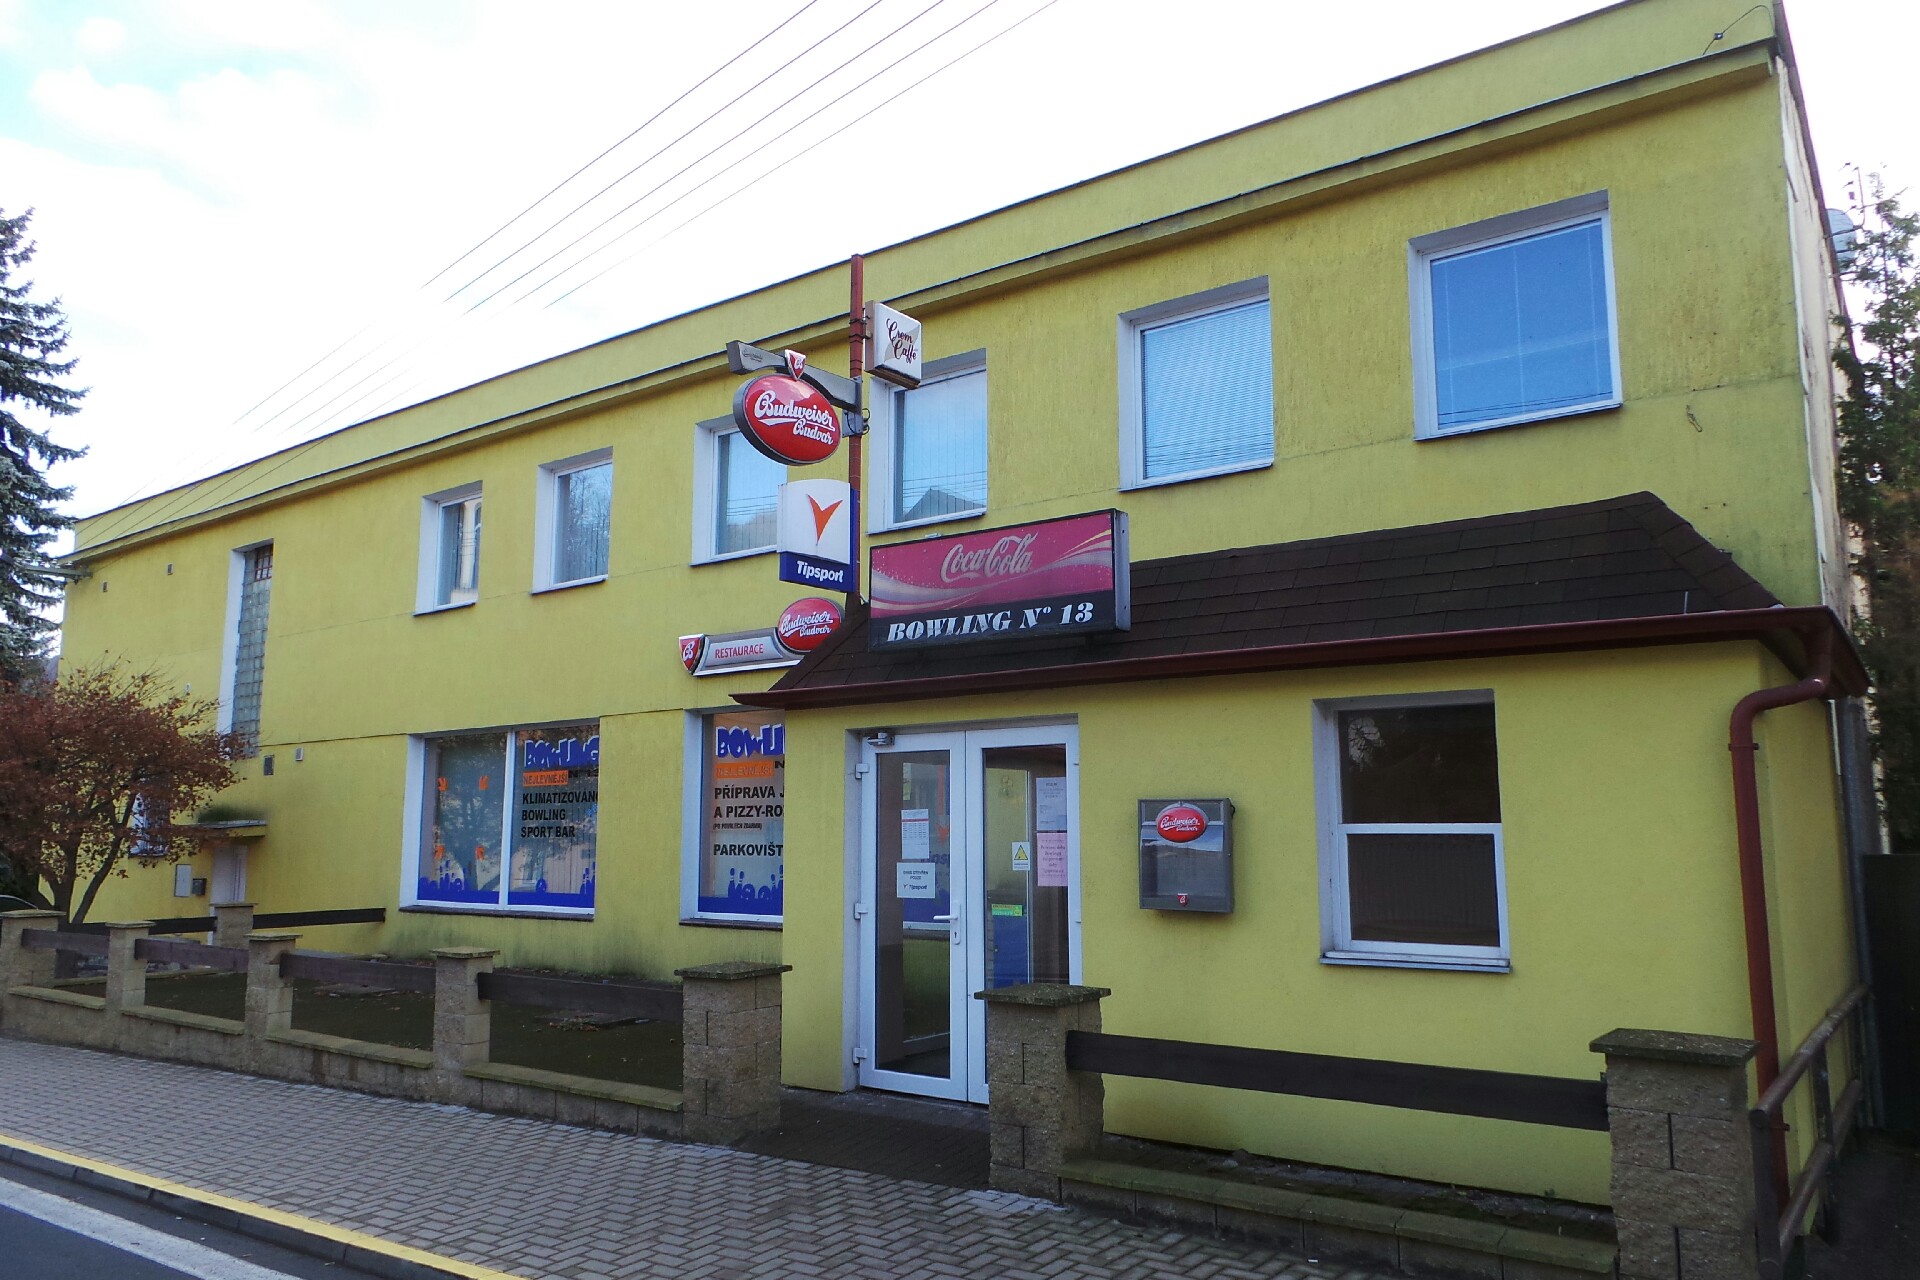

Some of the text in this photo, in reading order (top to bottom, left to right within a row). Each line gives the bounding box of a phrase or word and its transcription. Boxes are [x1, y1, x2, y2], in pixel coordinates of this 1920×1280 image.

[754, 389, 836, 431] Budweiser
[793, 419, 834, 445] Budvar
[797, 560, 845, 583] Tipsport
[780, 610, 834, 637] Budweiser
[887, 611, 1012, 642] BOWLING
[1060, 602, 1095, 625] 13
[799, 624, 832, 638] Budvar
[715, 643, 764, 659] RESTAURACE
[716, 723, 785, 758] BOWLI
[522, 789, 598, 805] KLIMATIZOVÁN
[714, 785, 776, 799] PŘÍPRAVA
[522, 809, 566, 821] BOWLING
[714, 805, 784, 818] A PIZZY-RO
[521, 826, 575, 838] SPORT BAR
